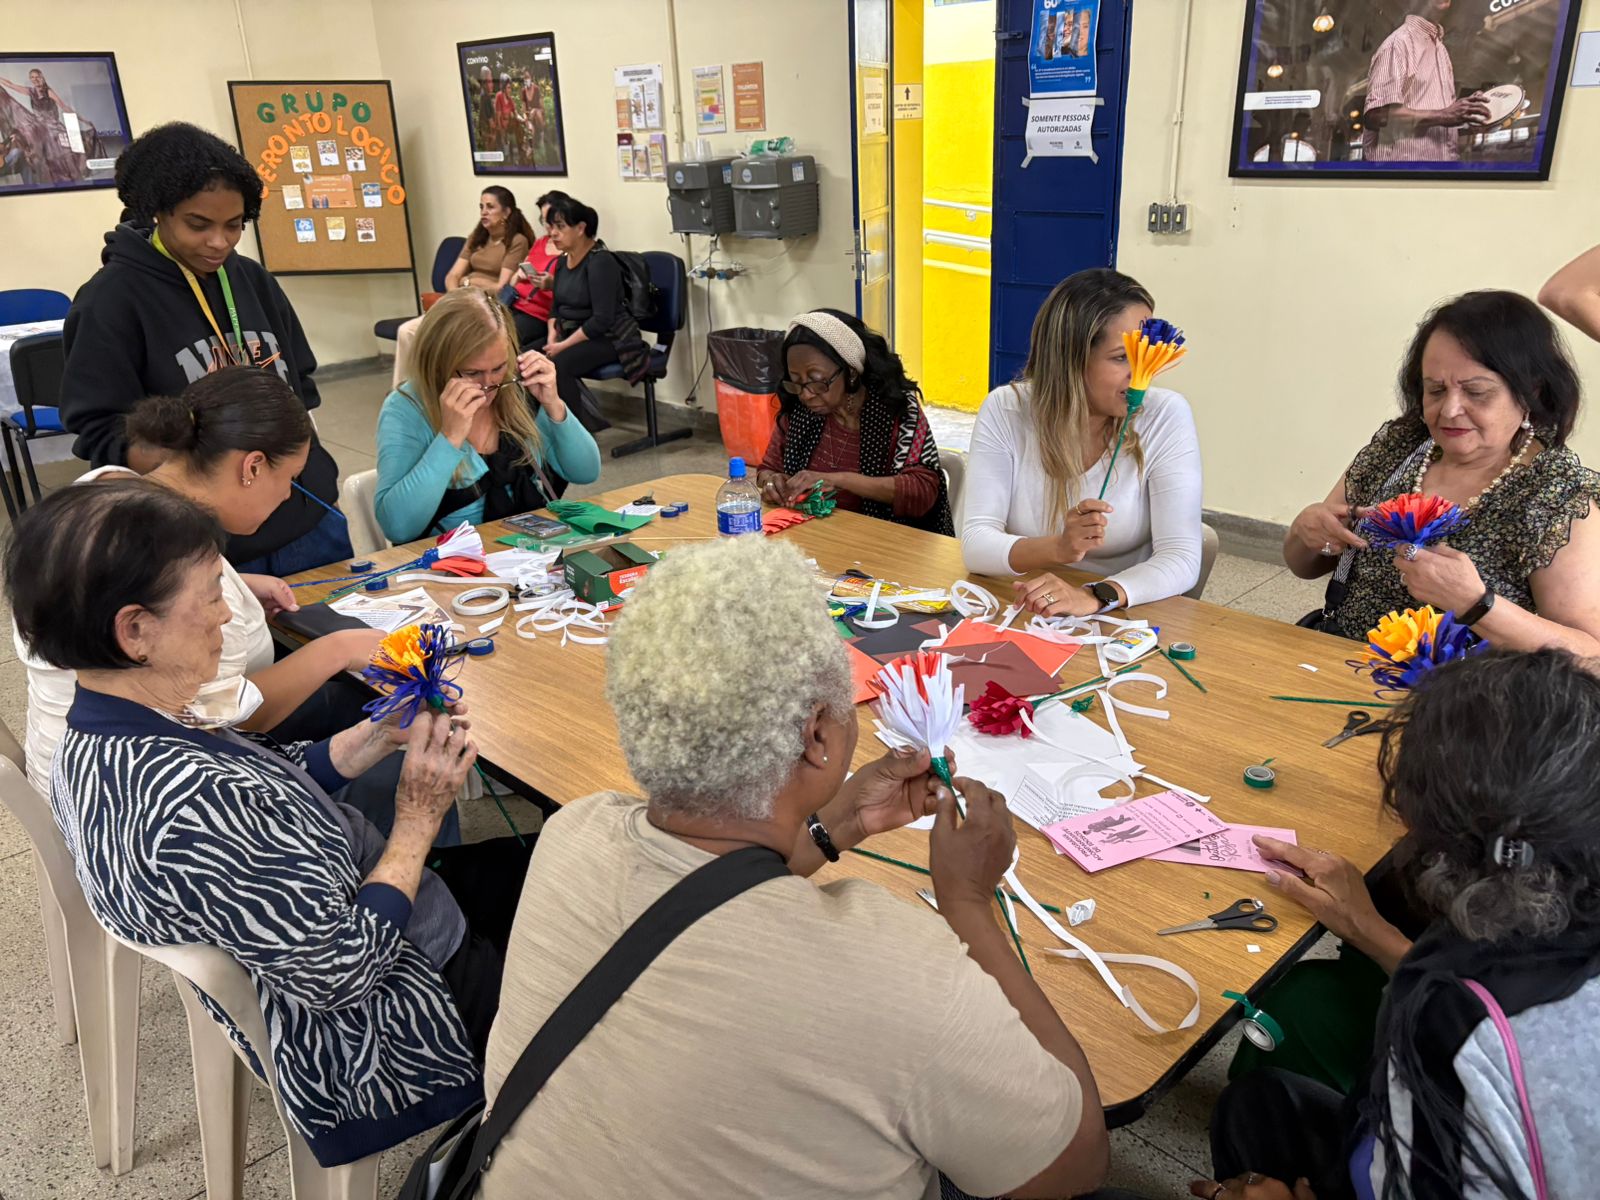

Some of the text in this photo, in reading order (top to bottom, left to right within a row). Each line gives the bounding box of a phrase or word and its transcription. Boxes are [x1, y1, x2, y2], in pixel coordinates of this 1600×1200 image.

[257, 89, 371, 123] GRUPO
[1037, 125, 1082, 133] AUTORIZADAS
[257, 112, 406, 205] ERONTOLOGICO
